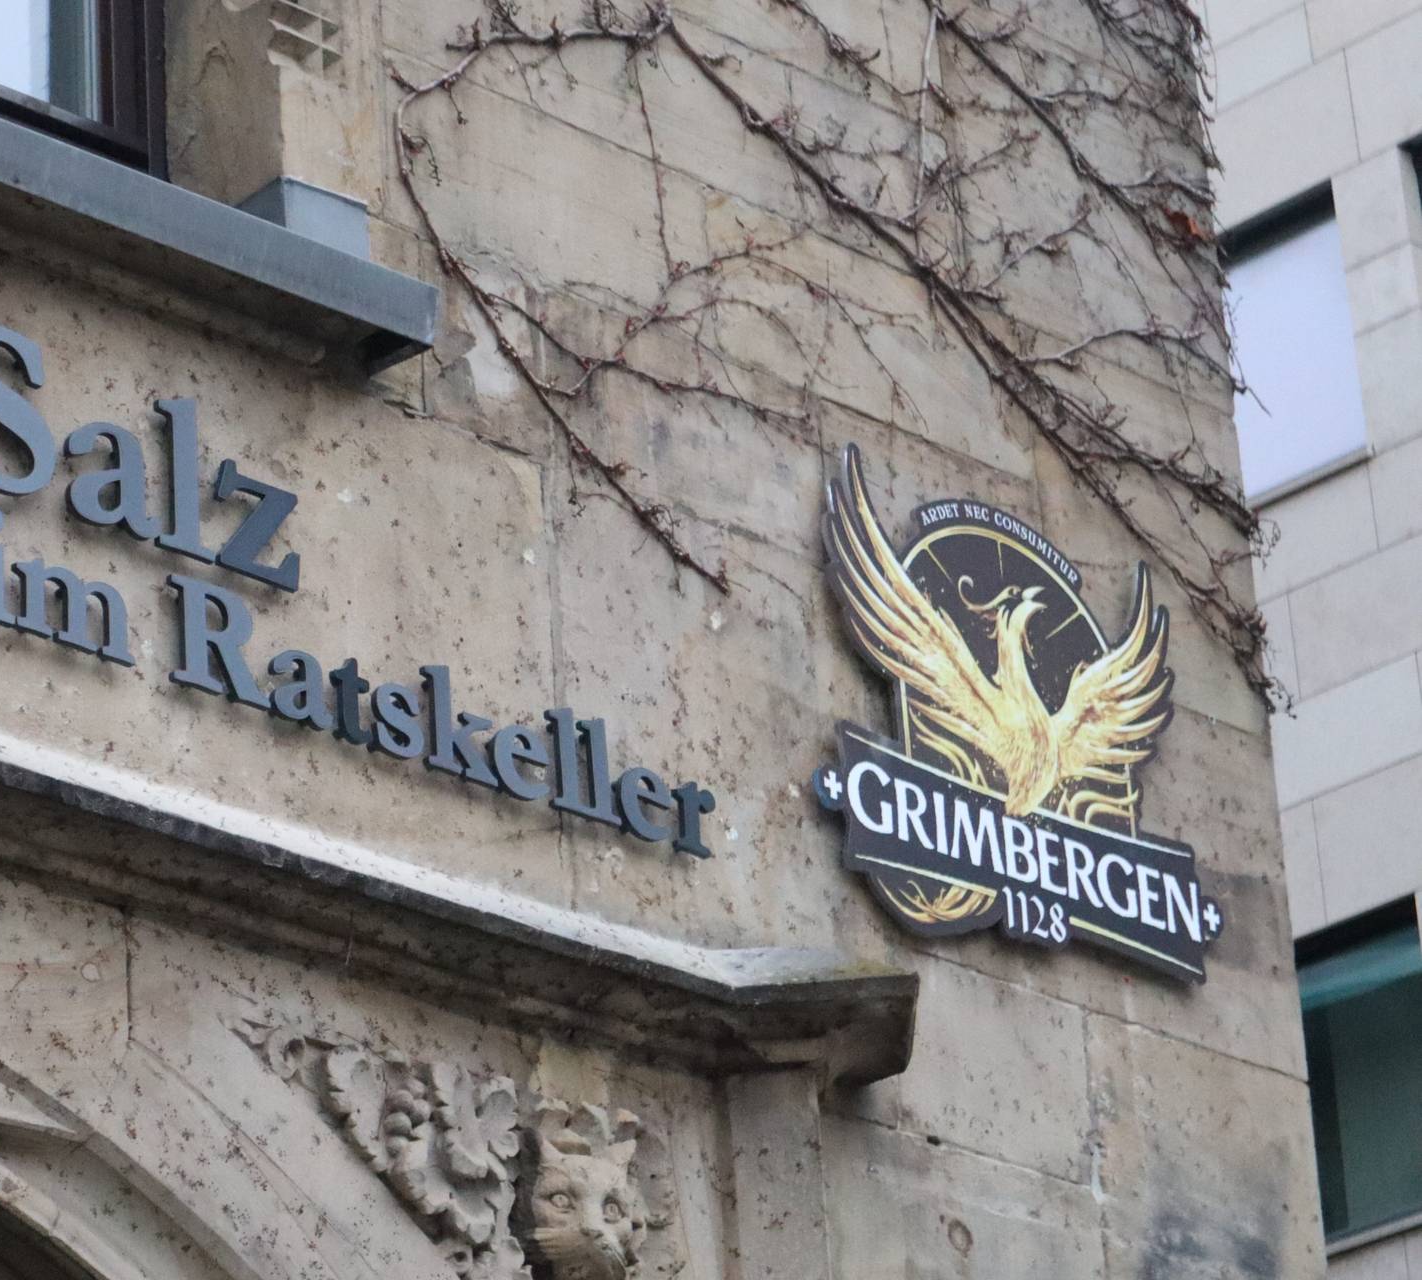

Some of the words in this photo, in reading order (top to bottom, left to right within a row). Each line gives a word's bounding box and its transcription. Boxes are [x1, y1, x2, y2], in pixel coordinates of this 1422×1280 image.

[920, 503, 960, 526] ARDET
[963, 505, 991, 522] NEC
[994, 511, 1079, 585] CONSUMITUR
[168, 573, 717, 860] Ratskeller
[846, 760, 1204, 943] GRIMBERGEN
[1001, 885, 1068, 943] 1128
